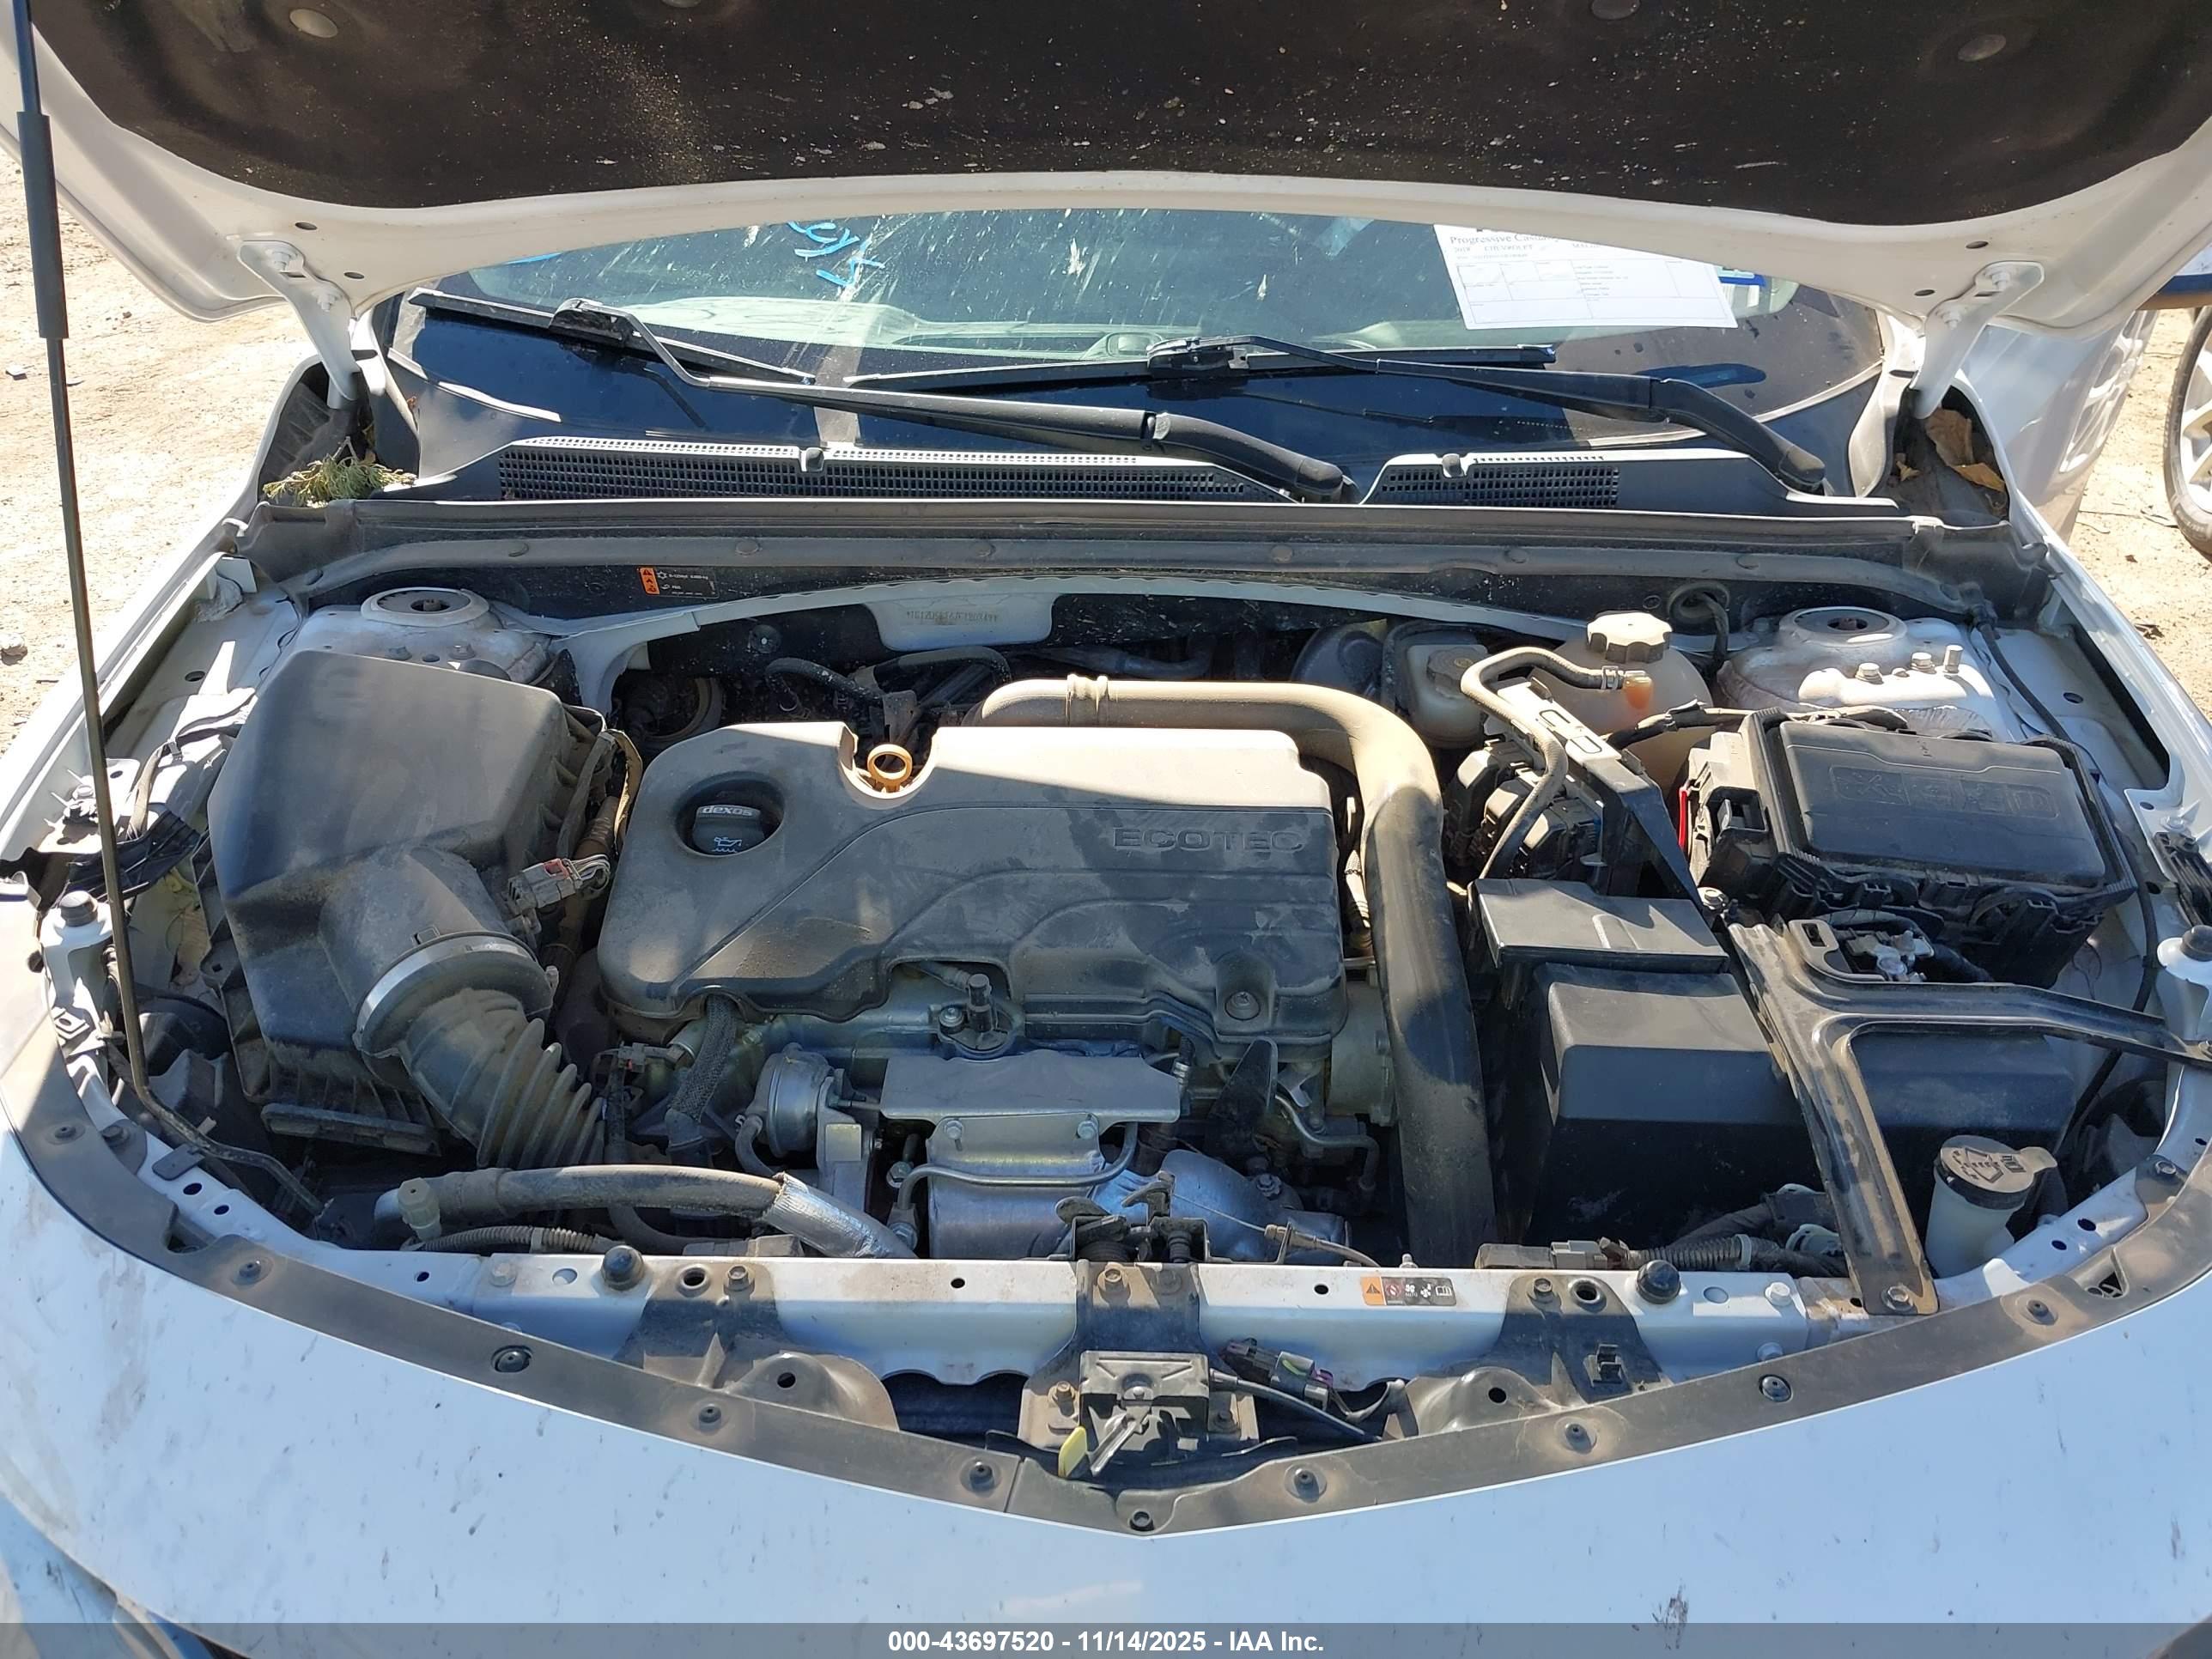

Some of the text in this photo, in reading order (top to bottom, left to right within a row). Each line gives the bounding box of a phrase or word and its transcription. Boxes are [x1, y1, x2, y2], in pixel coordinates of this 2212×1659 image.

[1449, 235, 1512, 245] Progressive
[702, 805, 753, 817] dexos
[1113, 827, 1306, 853] ECOTEC
